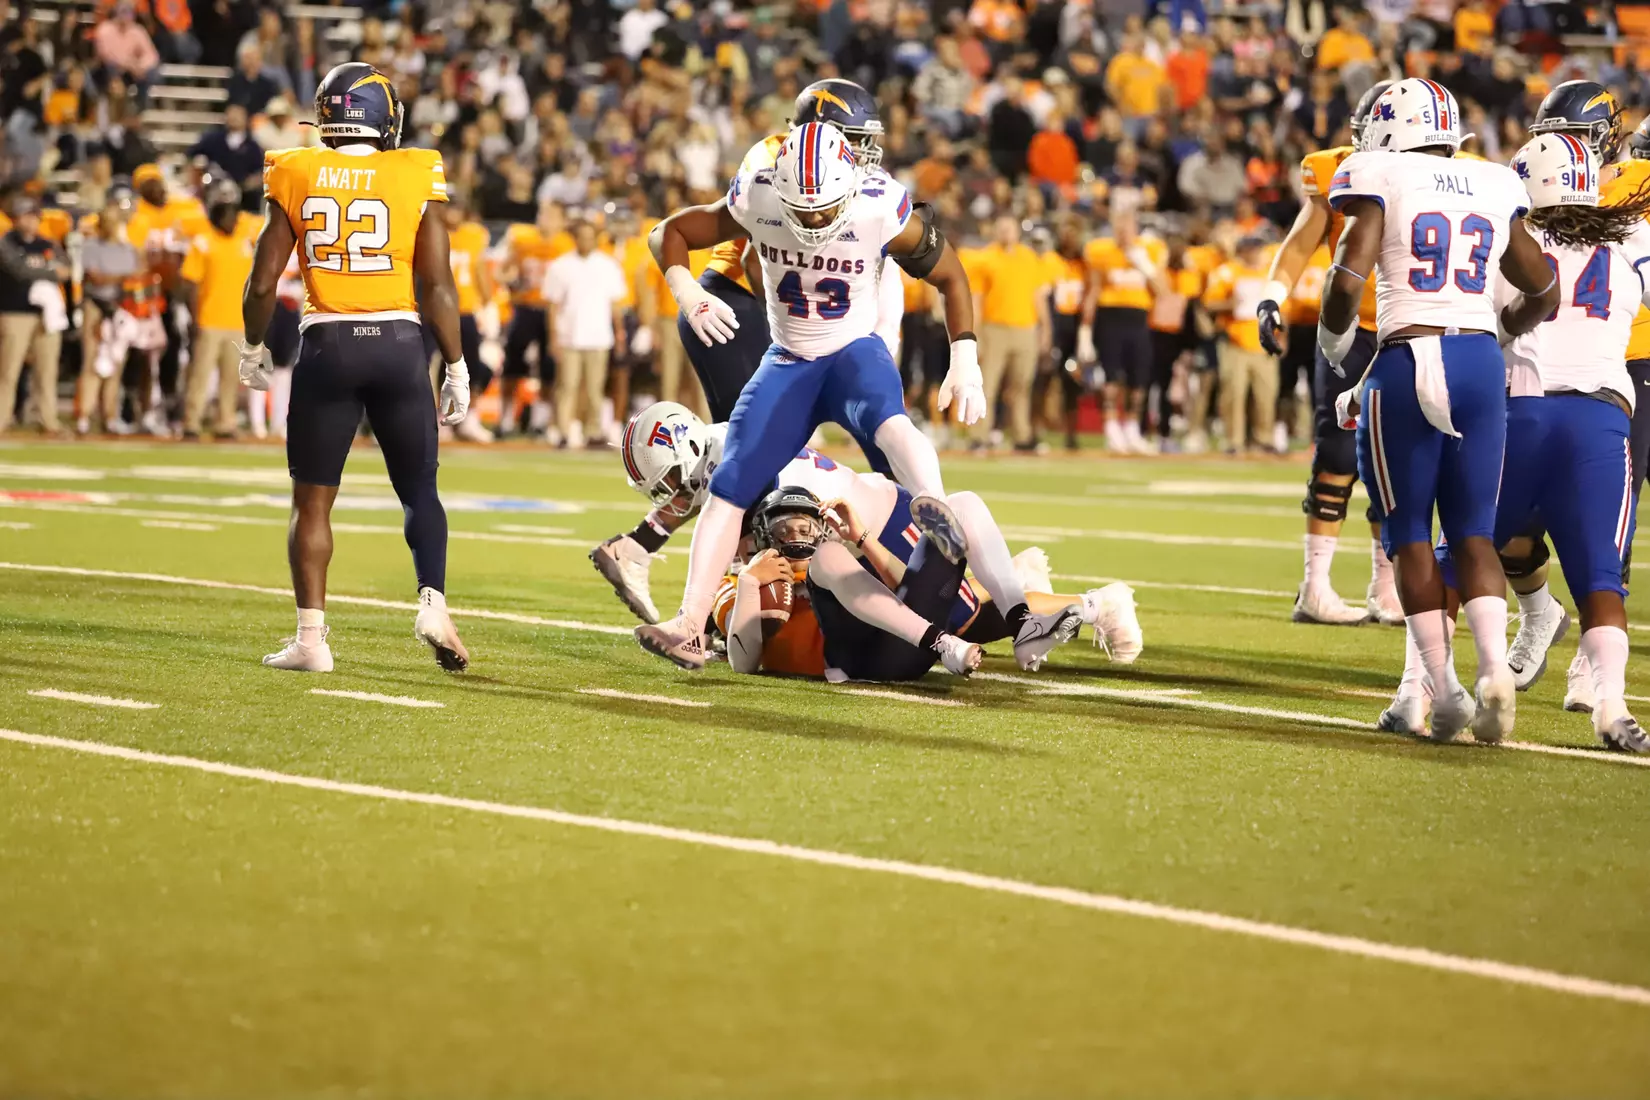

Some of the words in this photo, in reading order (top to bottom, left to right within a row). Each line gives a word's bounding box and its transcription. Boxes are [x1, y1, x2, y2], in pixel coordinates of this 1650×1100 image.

[322, 126, 362, 134] MINERS
[316, 166, 376, 190] AWATT
[301, 196, 394, 272] 22
[760, 242, 865, 275] BULLDOGS
[1408, 211, 1495, 294] 93
[776, 270, 852, 321] 43
[353, 326, 382, 337] MINERS
[681, 644, 703, 656] adidas
